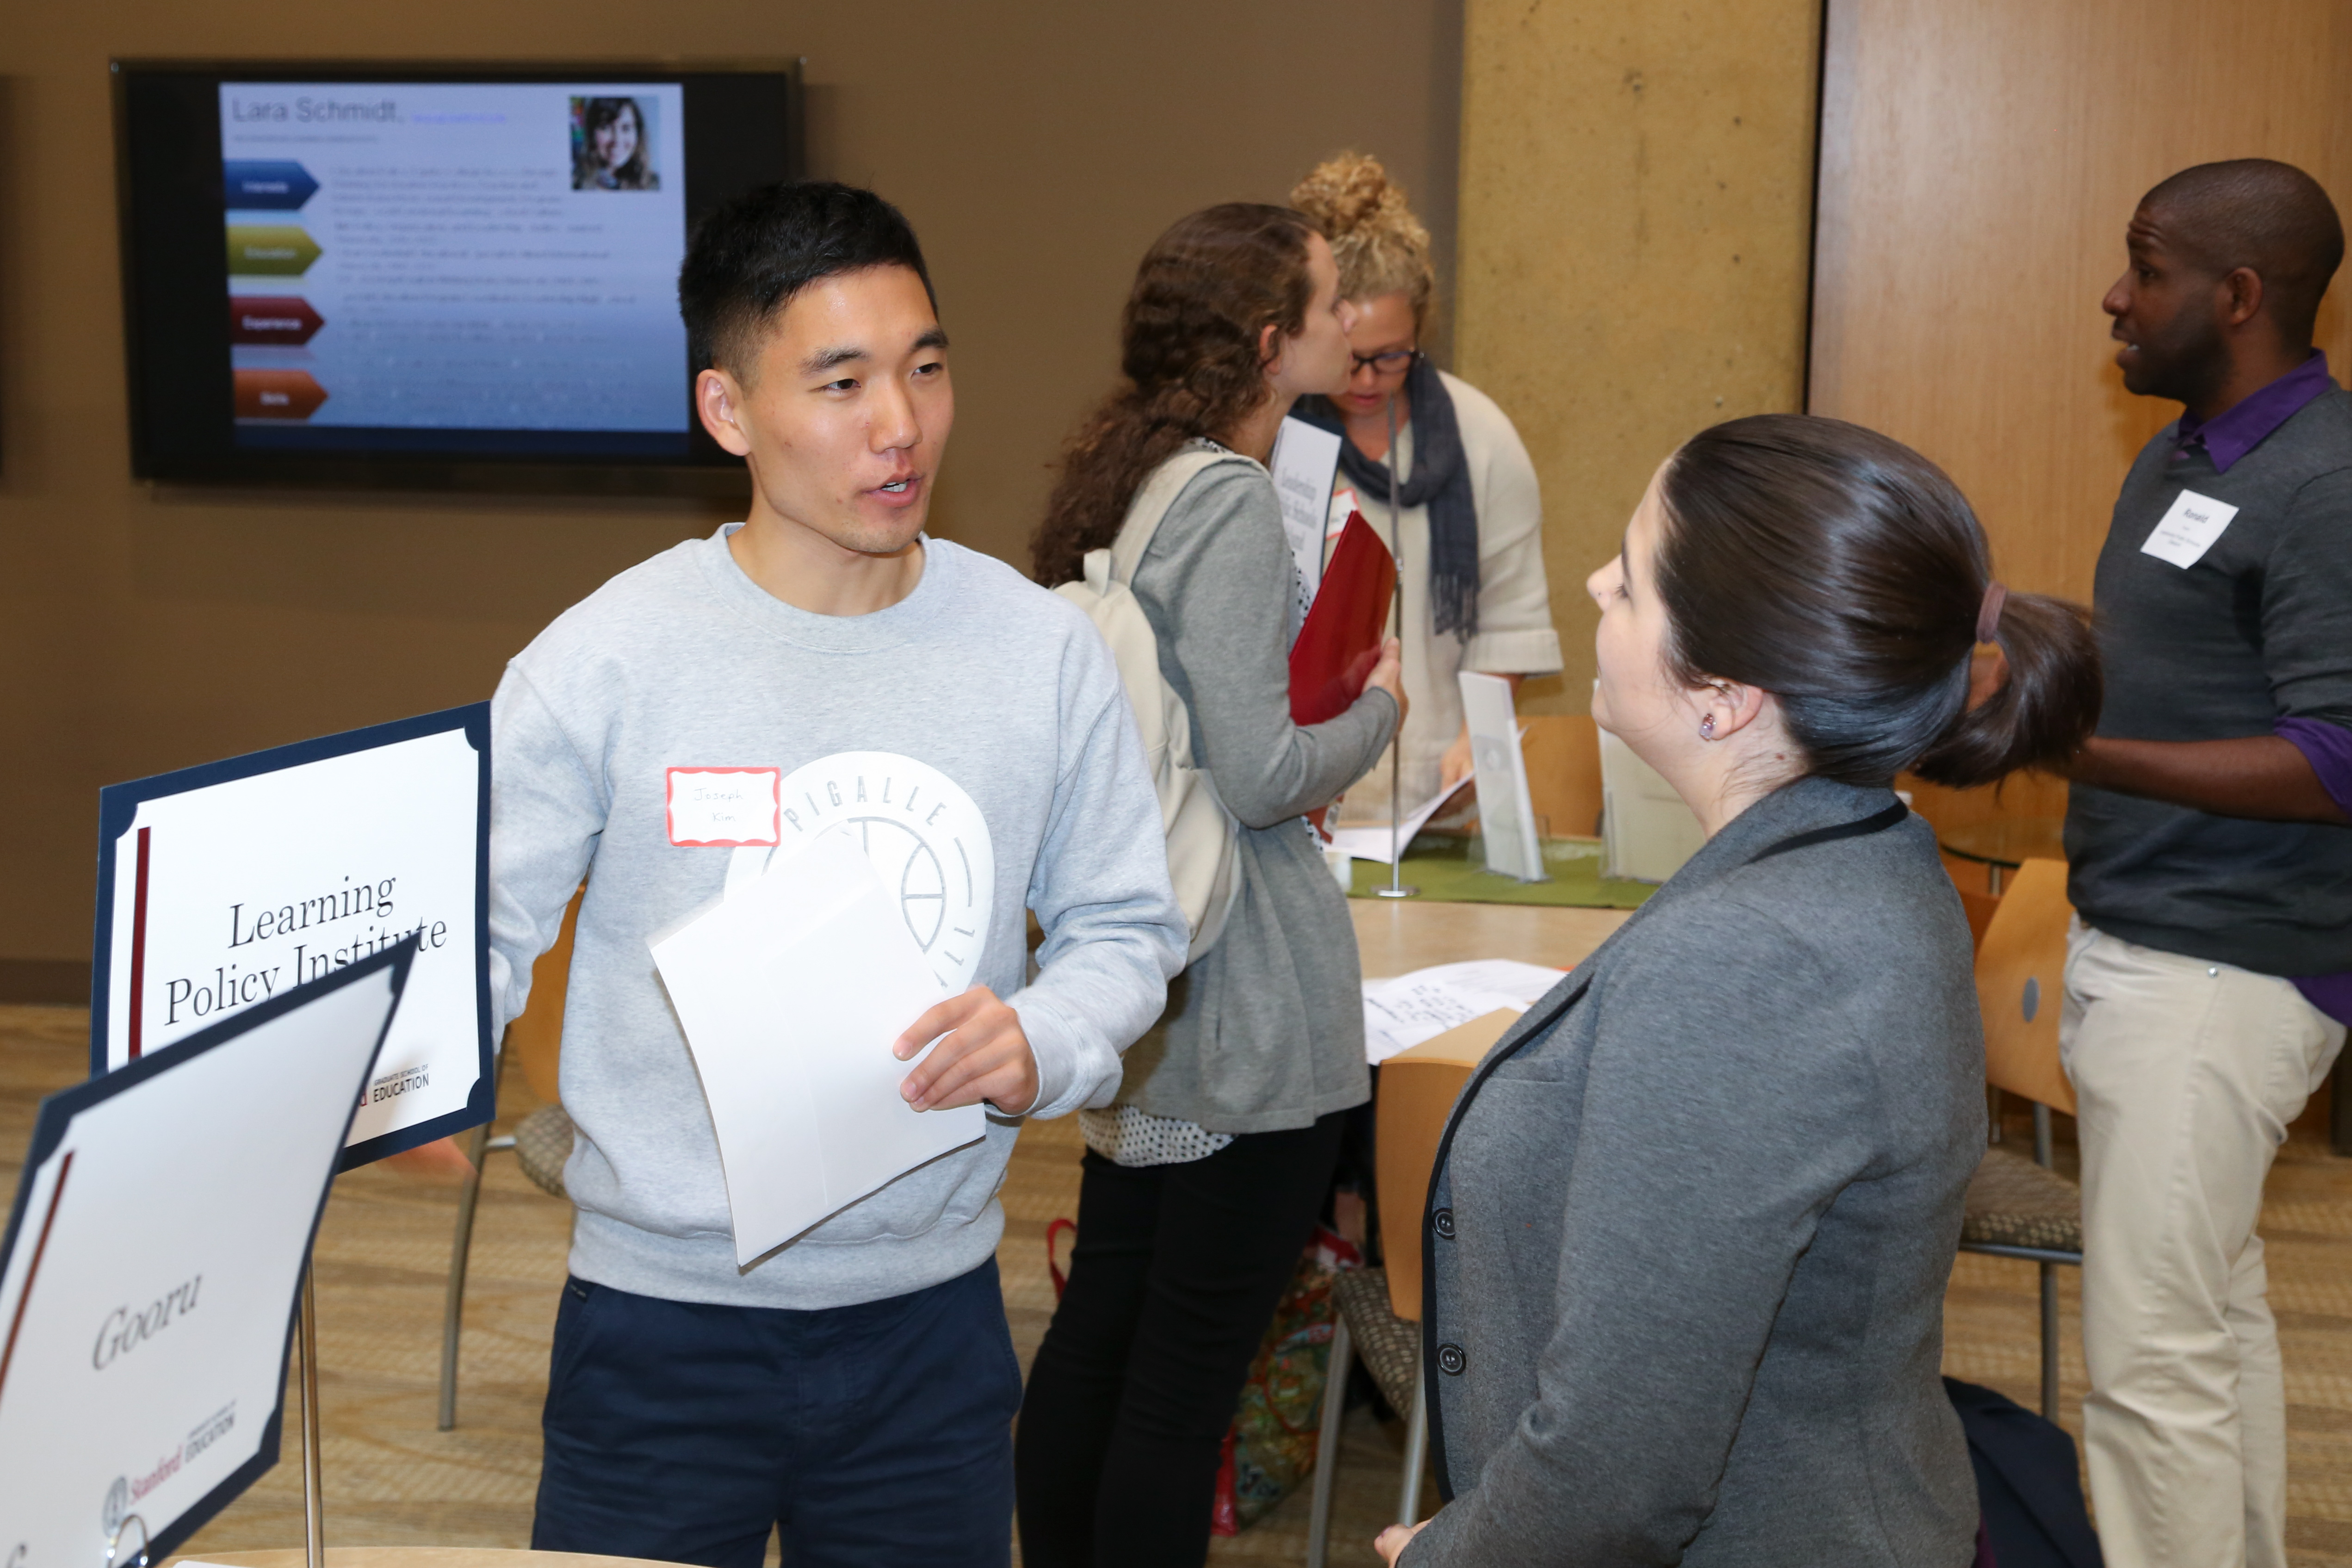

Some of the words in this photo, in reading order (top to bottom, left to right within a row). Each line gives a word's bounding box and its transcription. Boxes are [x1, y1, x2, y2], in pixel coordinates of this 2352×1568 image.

[232, 97, 288, 123] Lara
[2183, 508, 2210, 524] Ronald
[693, 787, 743, 802] Joseph
[784, 775, 947, 832] PIGALLE
[712, 812, 736, 822] Kim
[228, 875, 396, 948] Learning
[164, 963, 280, 1026] Policy
[373, 1073, 429, 1103] EDUCATION
[93, 1273, 202, 1371] Gooru
